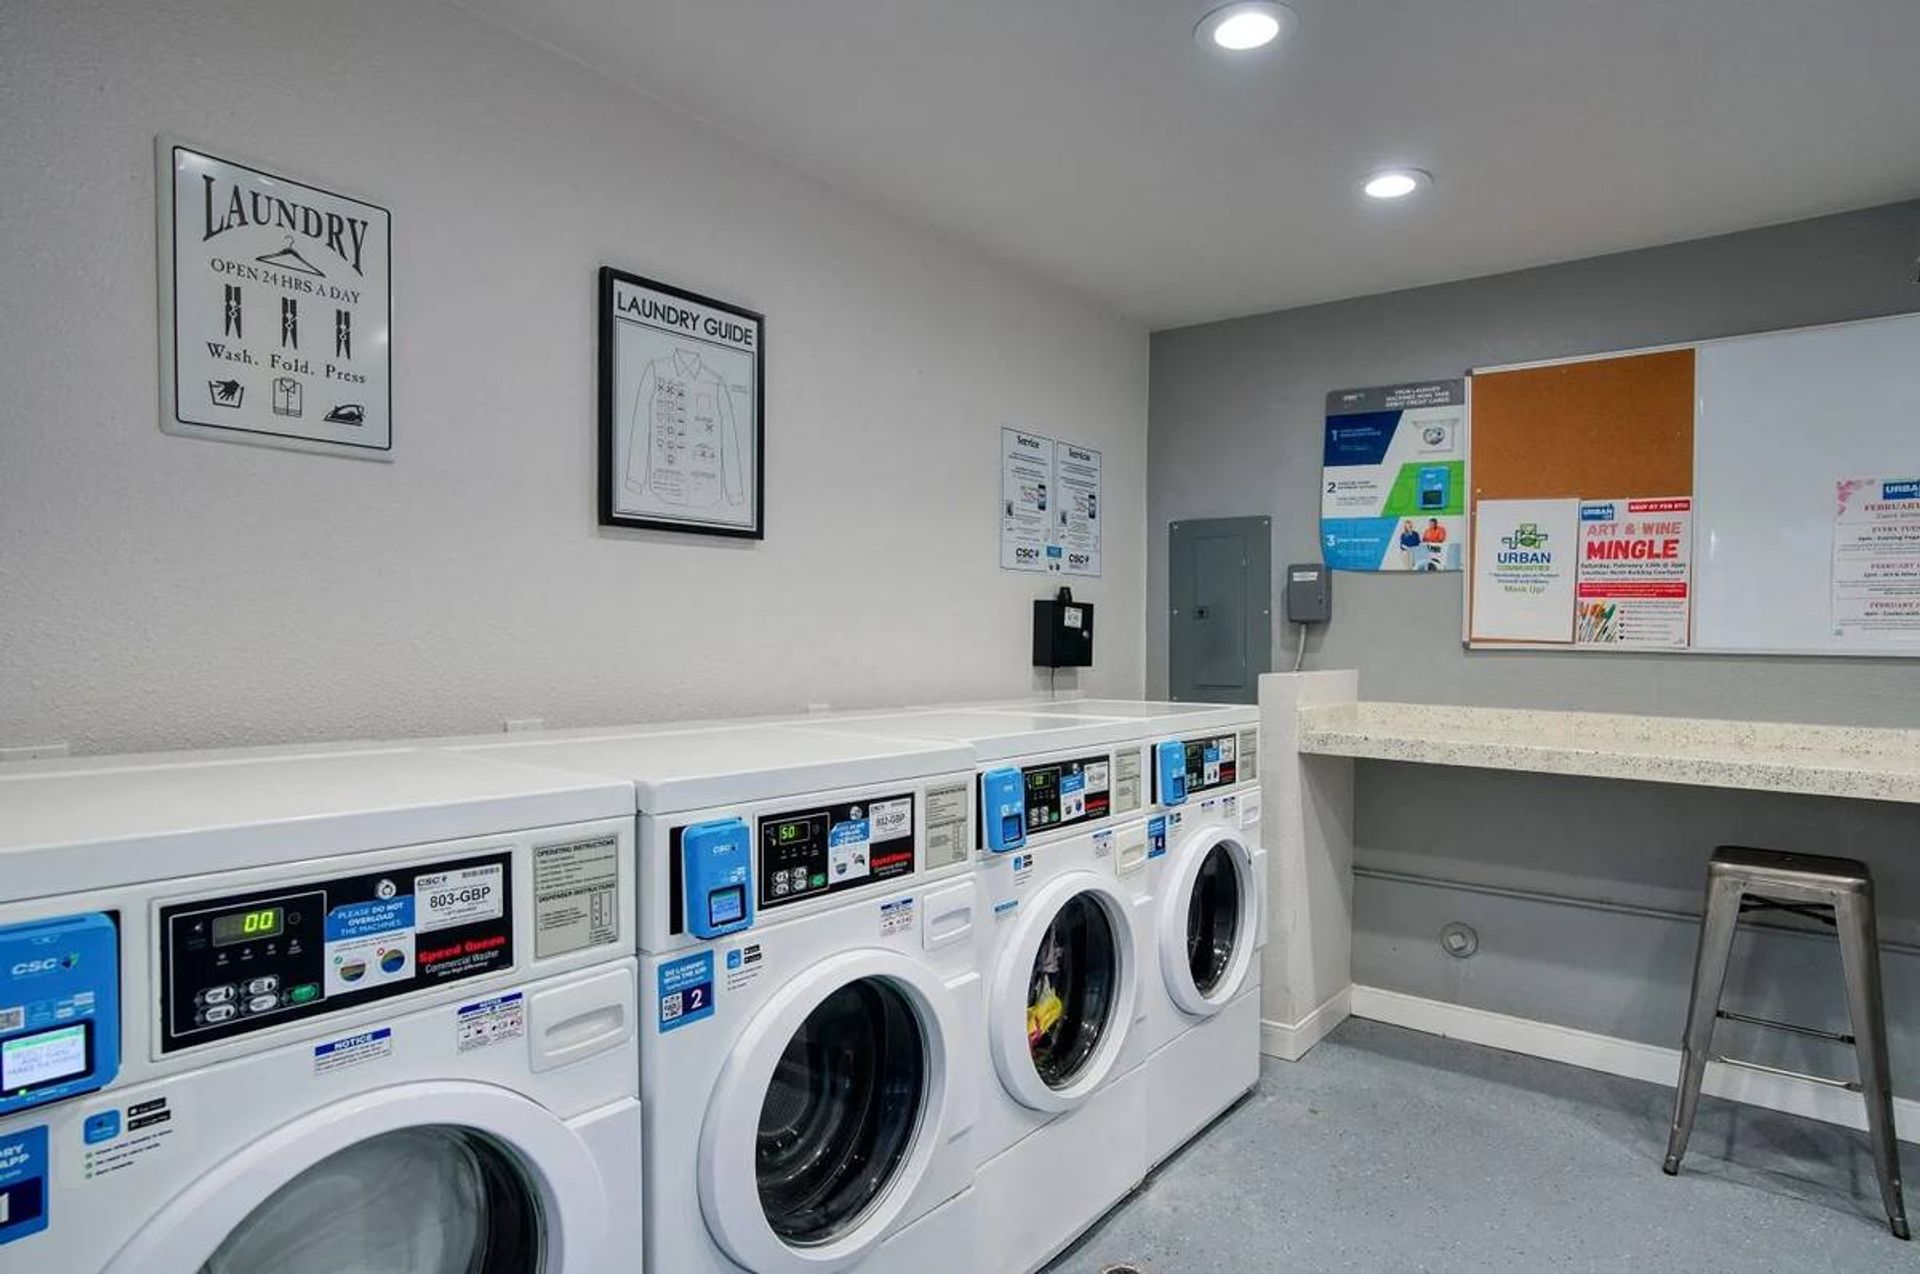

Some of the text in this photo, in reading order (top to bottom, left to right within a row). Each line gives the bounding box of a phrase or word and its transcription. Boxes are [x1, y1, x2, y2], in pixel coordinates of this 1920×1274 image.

[202, 173, 369, 277] LAUNDRY
[211, 258, 361, 304] OPEN 24 HRS A DAY
[617, 291, 753, 345] LAUNDRY GUIDE
[207, 341, 367, 386] Wash. Fold. Press
[1331, 429, 1338, 441] 1
[1327, 482, 1337, 494] 2
[1587, 521, 1683, 537] ART & WINE
[1326, 534, 1337, 547] 3
[1016, 546, 1034, 560] CSC
[1497, 552, 1552, 564] URBAN
[1586, 539, 1680, 560] MINGLE
[1069, 552, 1085, 565] CSC
[1156, 837, 1163, 847] 4
[417, 876, 441, 887] CSC
[430, 886, 492, 909] 803-GBP
[338, 902, 404, 919] PLEASE DO NOT
[348, 912, 395, 926] OVERLOAD
[244, 910, 274, 933] 00
[340, 927, 358, 936] THE
[419, 936, 505, 963] Speed Queen
[11, 957, 58, 976] CSC
[426, 949, 500, 974] Commercial Washer
[691, 988, 703, 1009] 2
[334, 1033, 374, 1050] NOTICE
